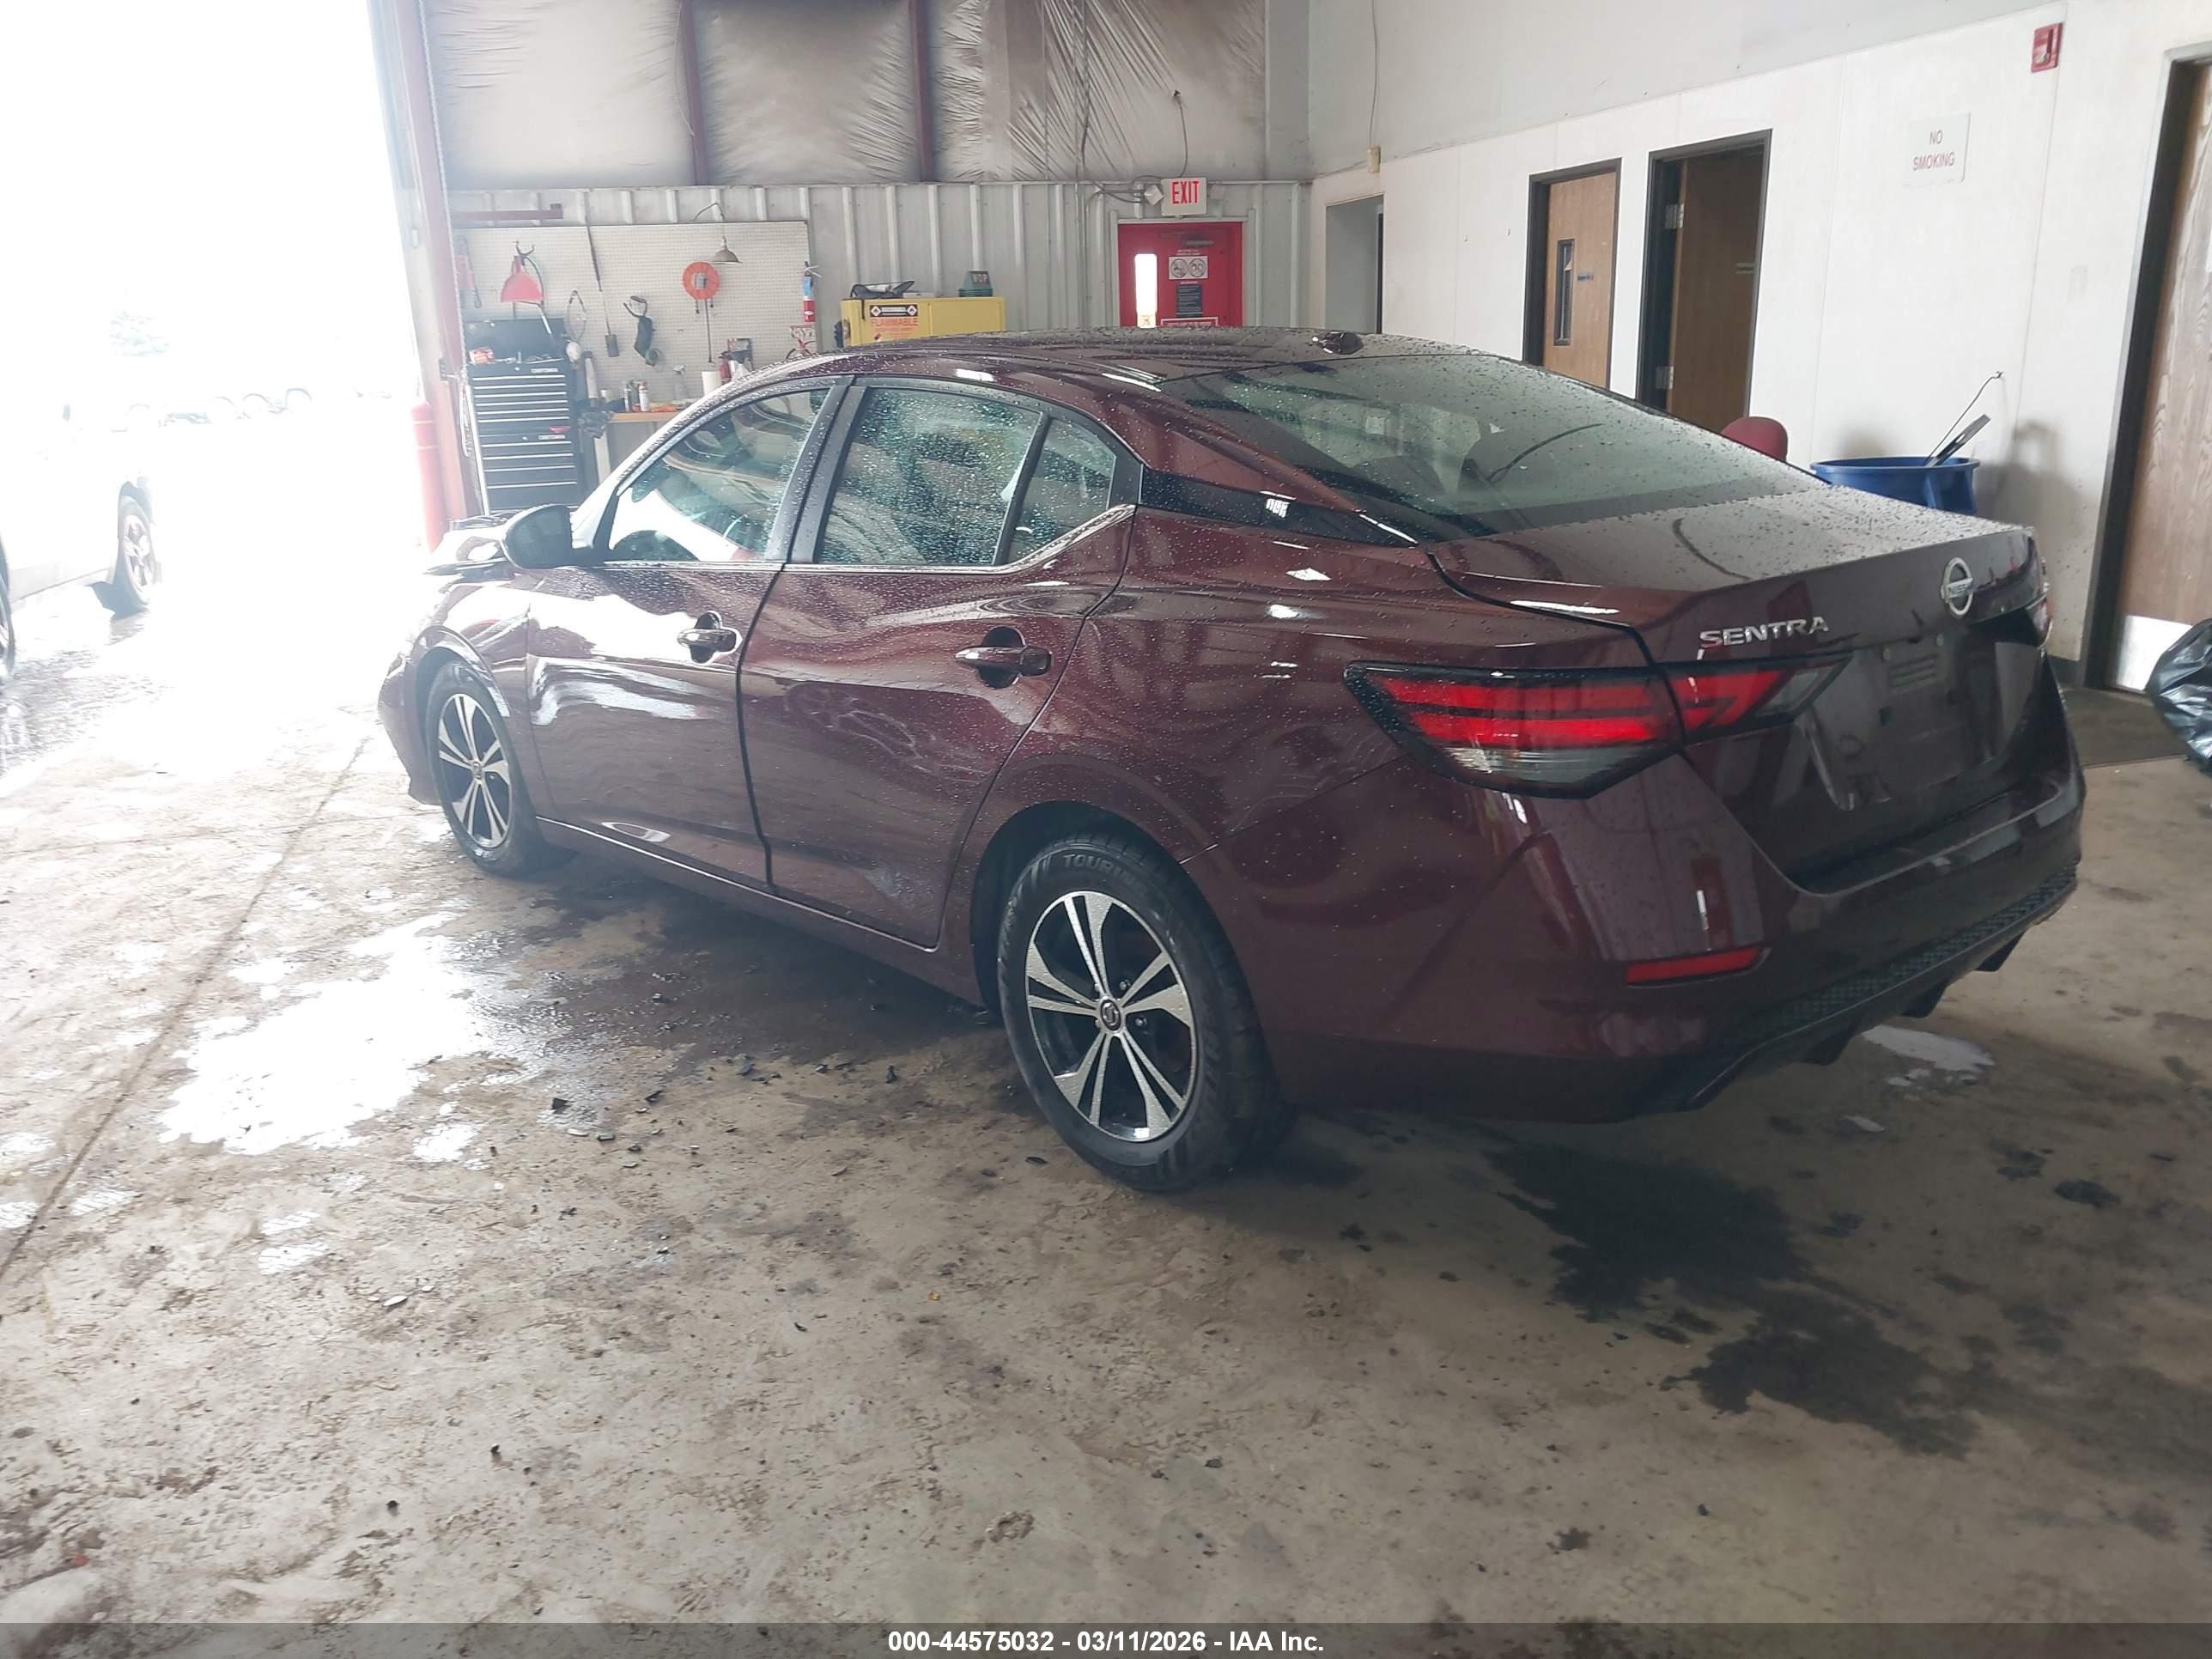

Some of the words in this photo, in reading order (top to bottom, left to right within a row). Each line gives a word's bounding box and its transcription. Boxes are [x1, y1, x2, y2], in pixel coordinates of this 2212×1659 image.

[1929, 130, 1943, 145] NO
[1912, 151, 1955, 171] SMOKING
[1171, 179, 1200, 204] EXIT
[1699, 616, 1830, 649] SENTRA
